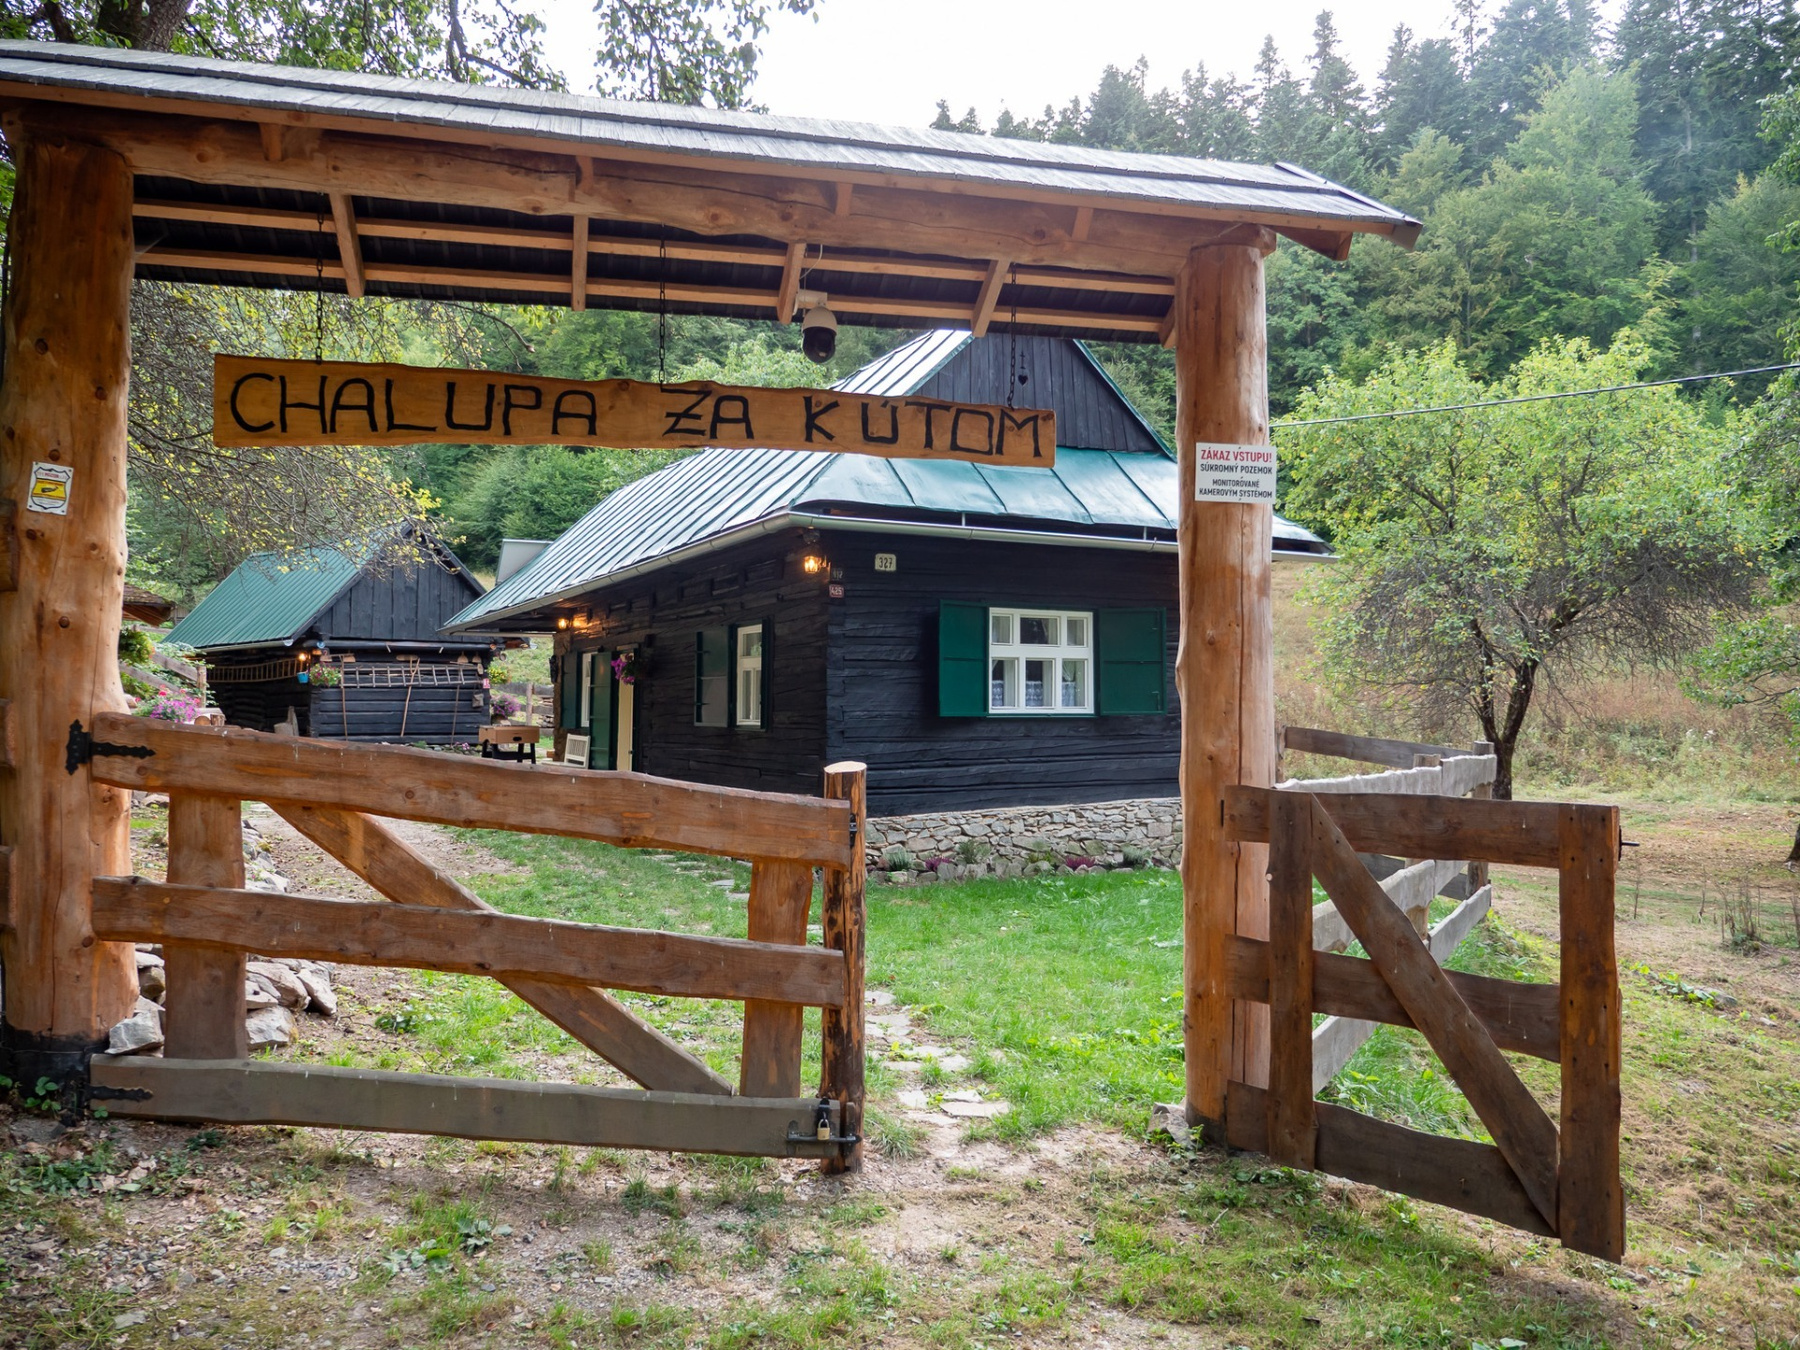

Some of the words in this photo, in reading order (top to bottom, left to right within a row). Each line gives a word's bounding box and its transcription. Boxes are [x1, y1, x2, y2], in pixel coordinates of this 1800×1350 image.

[230, 372, 598, 436] CHALUPA
[660, 386, 754, 440] ZA
[803, 395, 1042, 458] KÚTOM
[1201, 447, 1231, 461] ZÁKAZ
[1233, 451, 1272, 463] VSTUPU!
[1200, 461, 1239, 473] SÚKROMNÝ
[1240, 465, 1273, 475] POZEMOK
[1199, 487, 1238, 497] KAMEROVÝM
[1239, 489, 1273, 499] SYSTÉMOM
[878, 556, 893, 569] 327
